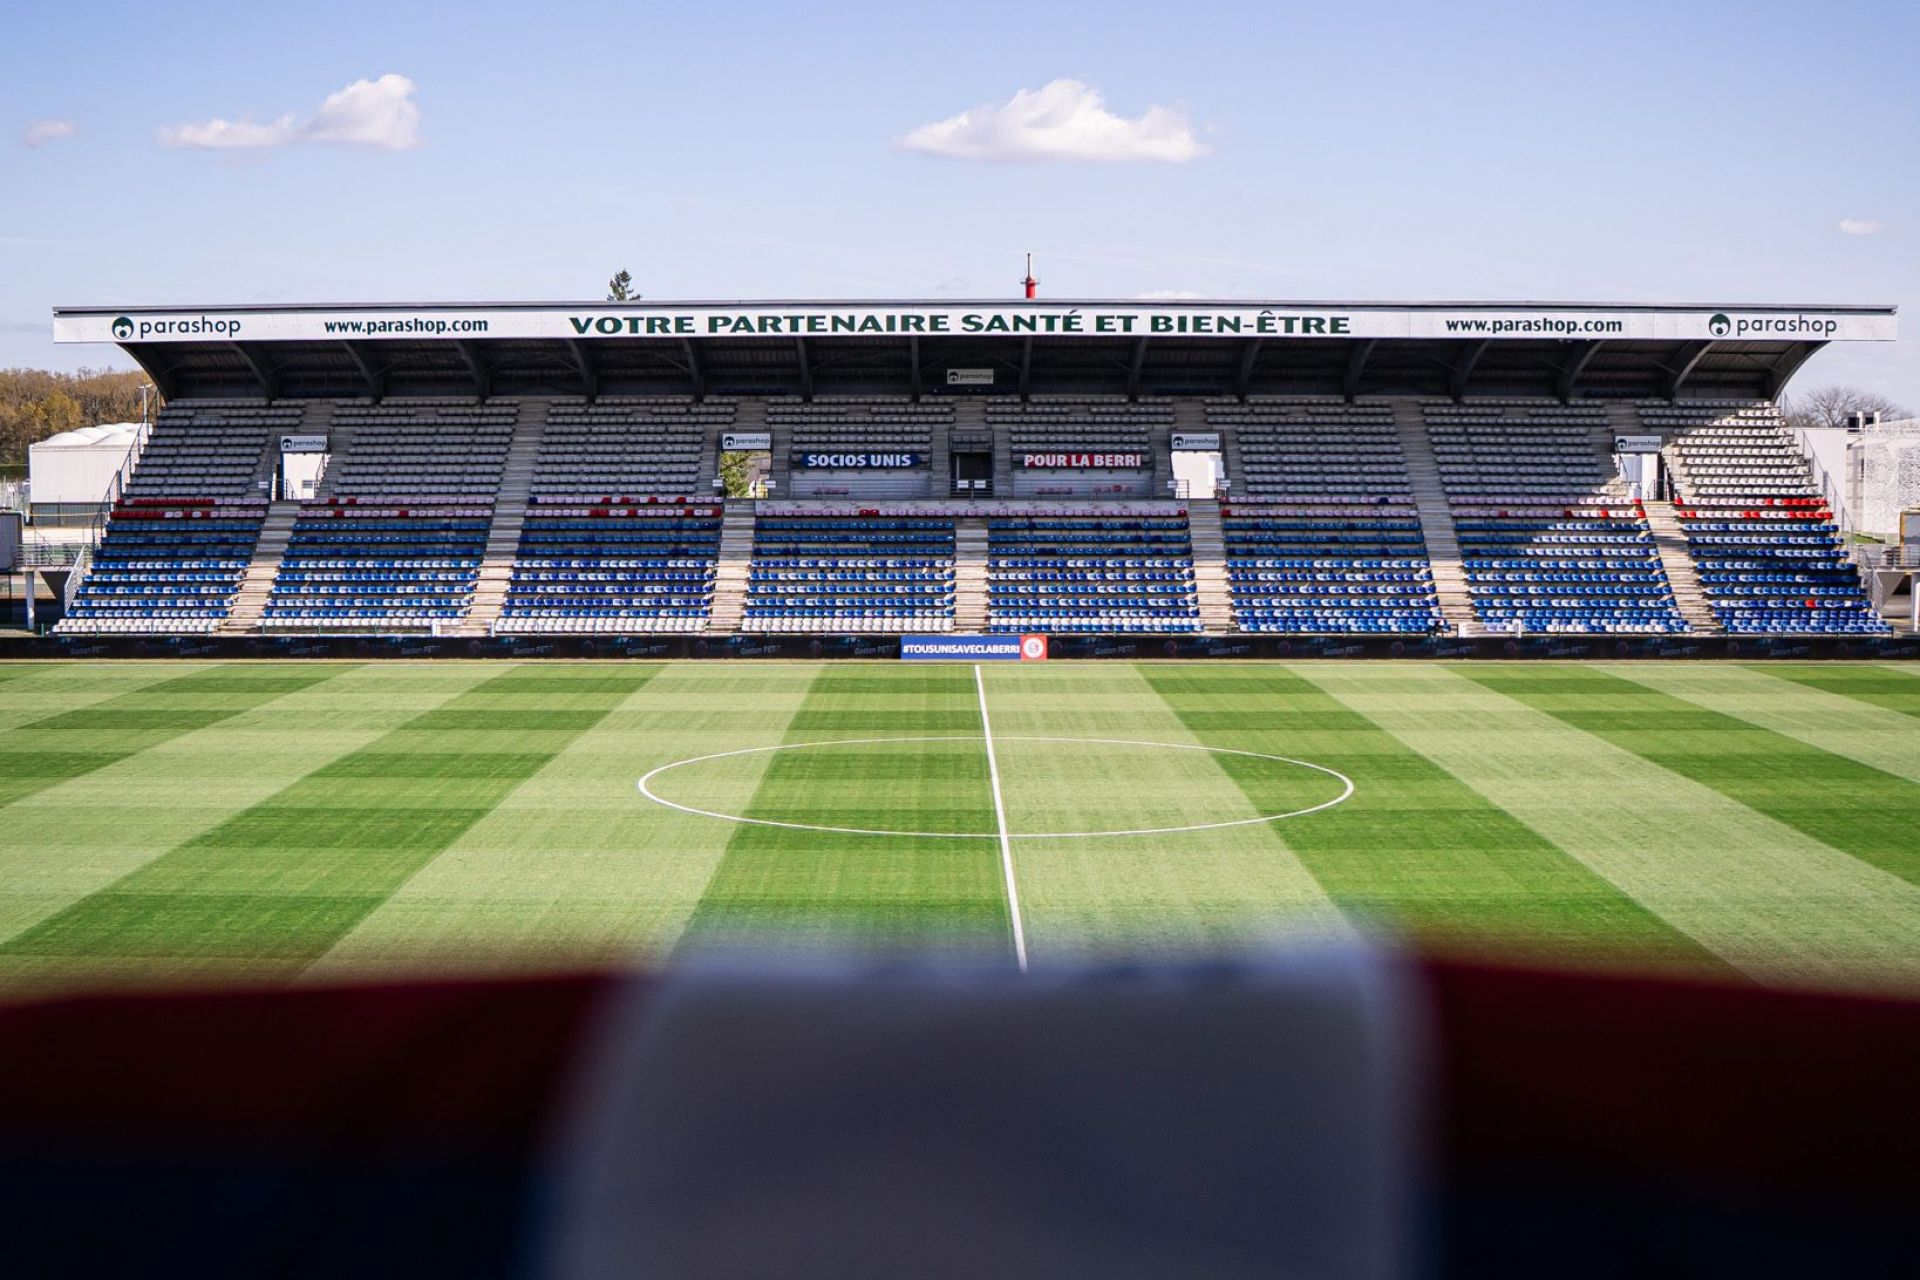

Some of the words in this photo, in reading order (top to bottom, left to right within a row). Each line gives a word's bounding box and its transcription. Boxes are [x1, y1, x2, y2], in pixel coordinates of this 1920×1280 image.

[140, 315, 240, 338] parashop
[325, 318, 488, 335] www.parashop.com
[569, 317, 695, 334] VOTRE
[709, 315, 949, 333] PARTENAIRE
[962, 310, 1083, 332] SANTÉ
[1096, 316, 1138, 332] ET
[1151, 310, 1350, 333] BIEN-ÊTRE
[1446, 318, 1622, 334] www.parashop.com
[1737, 315, 1837, 336] parashop
[735, 437, 770, 445] parashop
[1184, 437, 1219, 445] parashop
[807, 454, 866, 467] SOCIOS
[871, 454, 911, 467] UNIS
[1024, 454, 1067, 467] POUR
[1071, 454, 1090, 467] LA
[1094, 454, 1141, 467] BERRI
[903, 644, 1020, 654] #TOUSUNISAVECLABERRI
